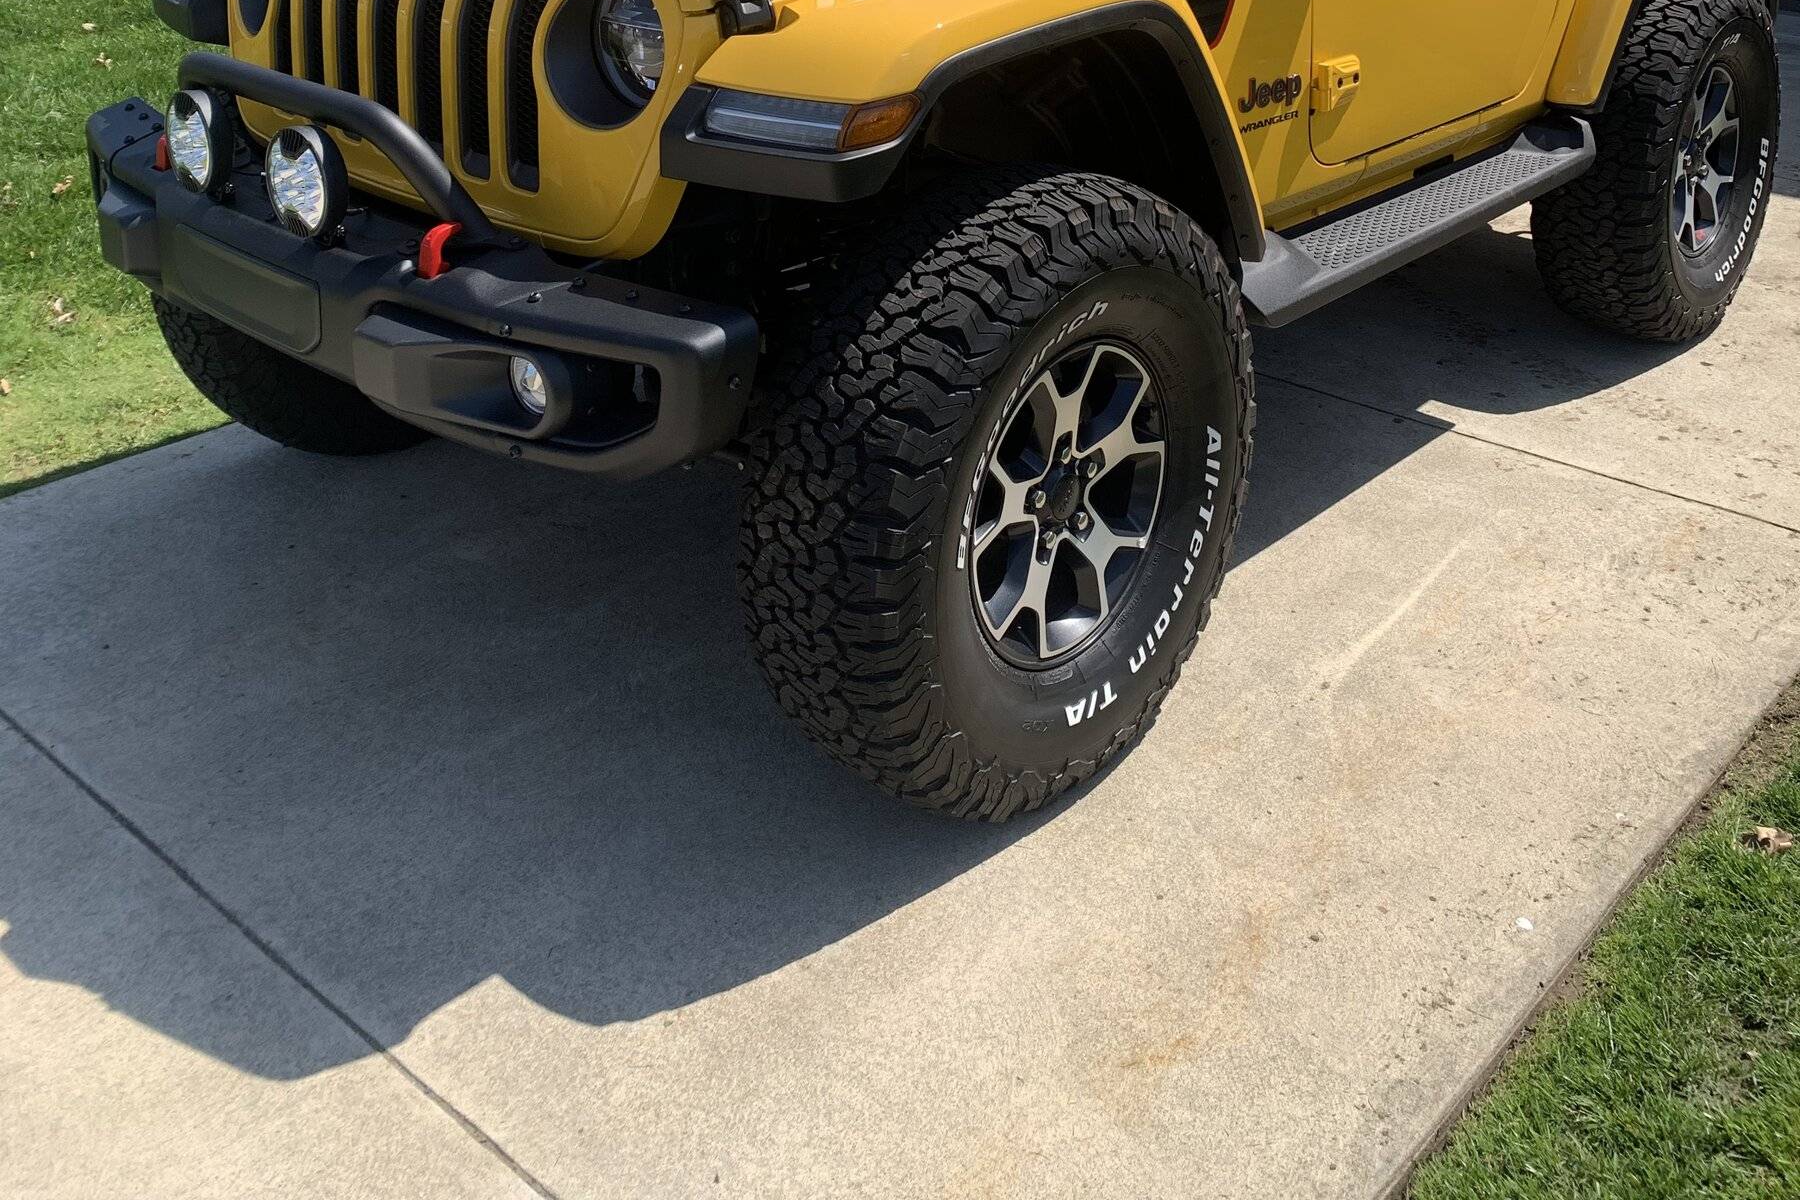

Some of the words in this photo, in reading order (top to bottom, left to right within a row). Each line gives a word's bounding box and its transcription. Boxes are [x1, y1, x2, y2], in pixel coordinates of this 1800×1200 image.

[1238, 74, 1302, 113] Jeep
[1240, 110, 1299, 134] WRANGLER
[1714, 137, 1770, 283] BFGoodrich
[956, 300, 1109, 570] BFGoodrich
[1128, 425, 1222, 674] All-Terrain
[1064, 681, 1118, 727] T/A
